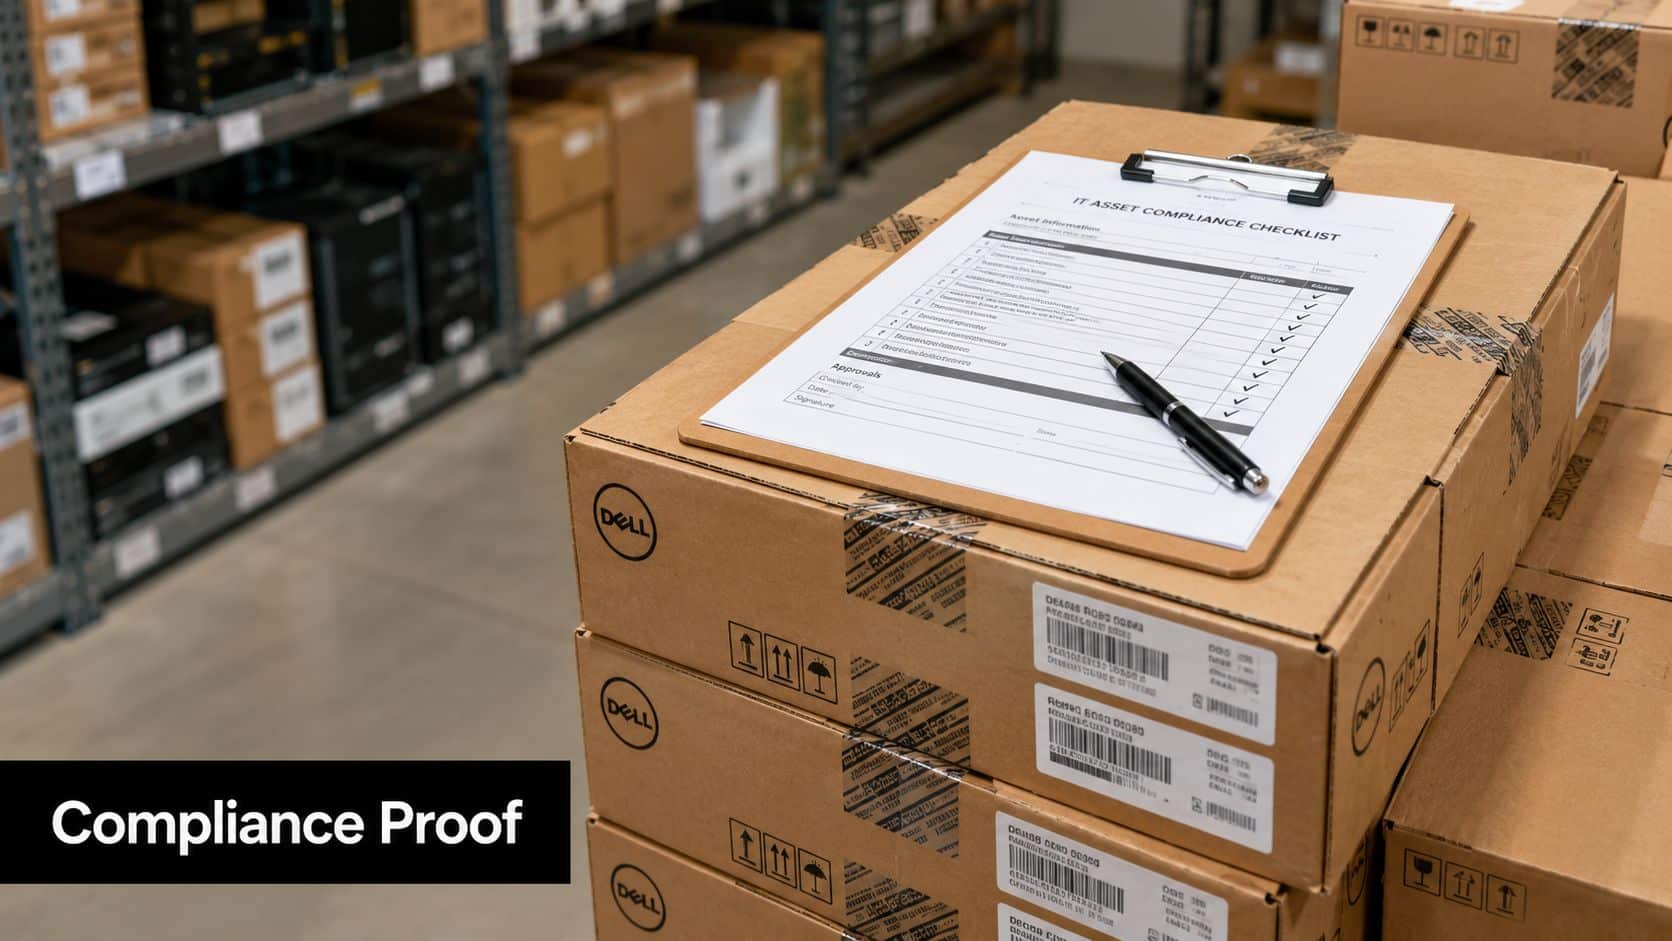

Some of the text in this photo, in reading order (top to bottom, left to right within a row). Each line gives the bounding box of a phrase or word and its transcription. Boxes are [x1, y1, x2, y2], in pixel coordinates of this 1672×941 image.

[1072, 196, 1341, 242] IT ASSET COMPLIANCE CHECKLIST
[831, 363, 882, 379] Approvals
[600, 507, 650, 538] DELL
[607, 699, 654, 731] DELL
[616, 880, 661, 915] DELL
